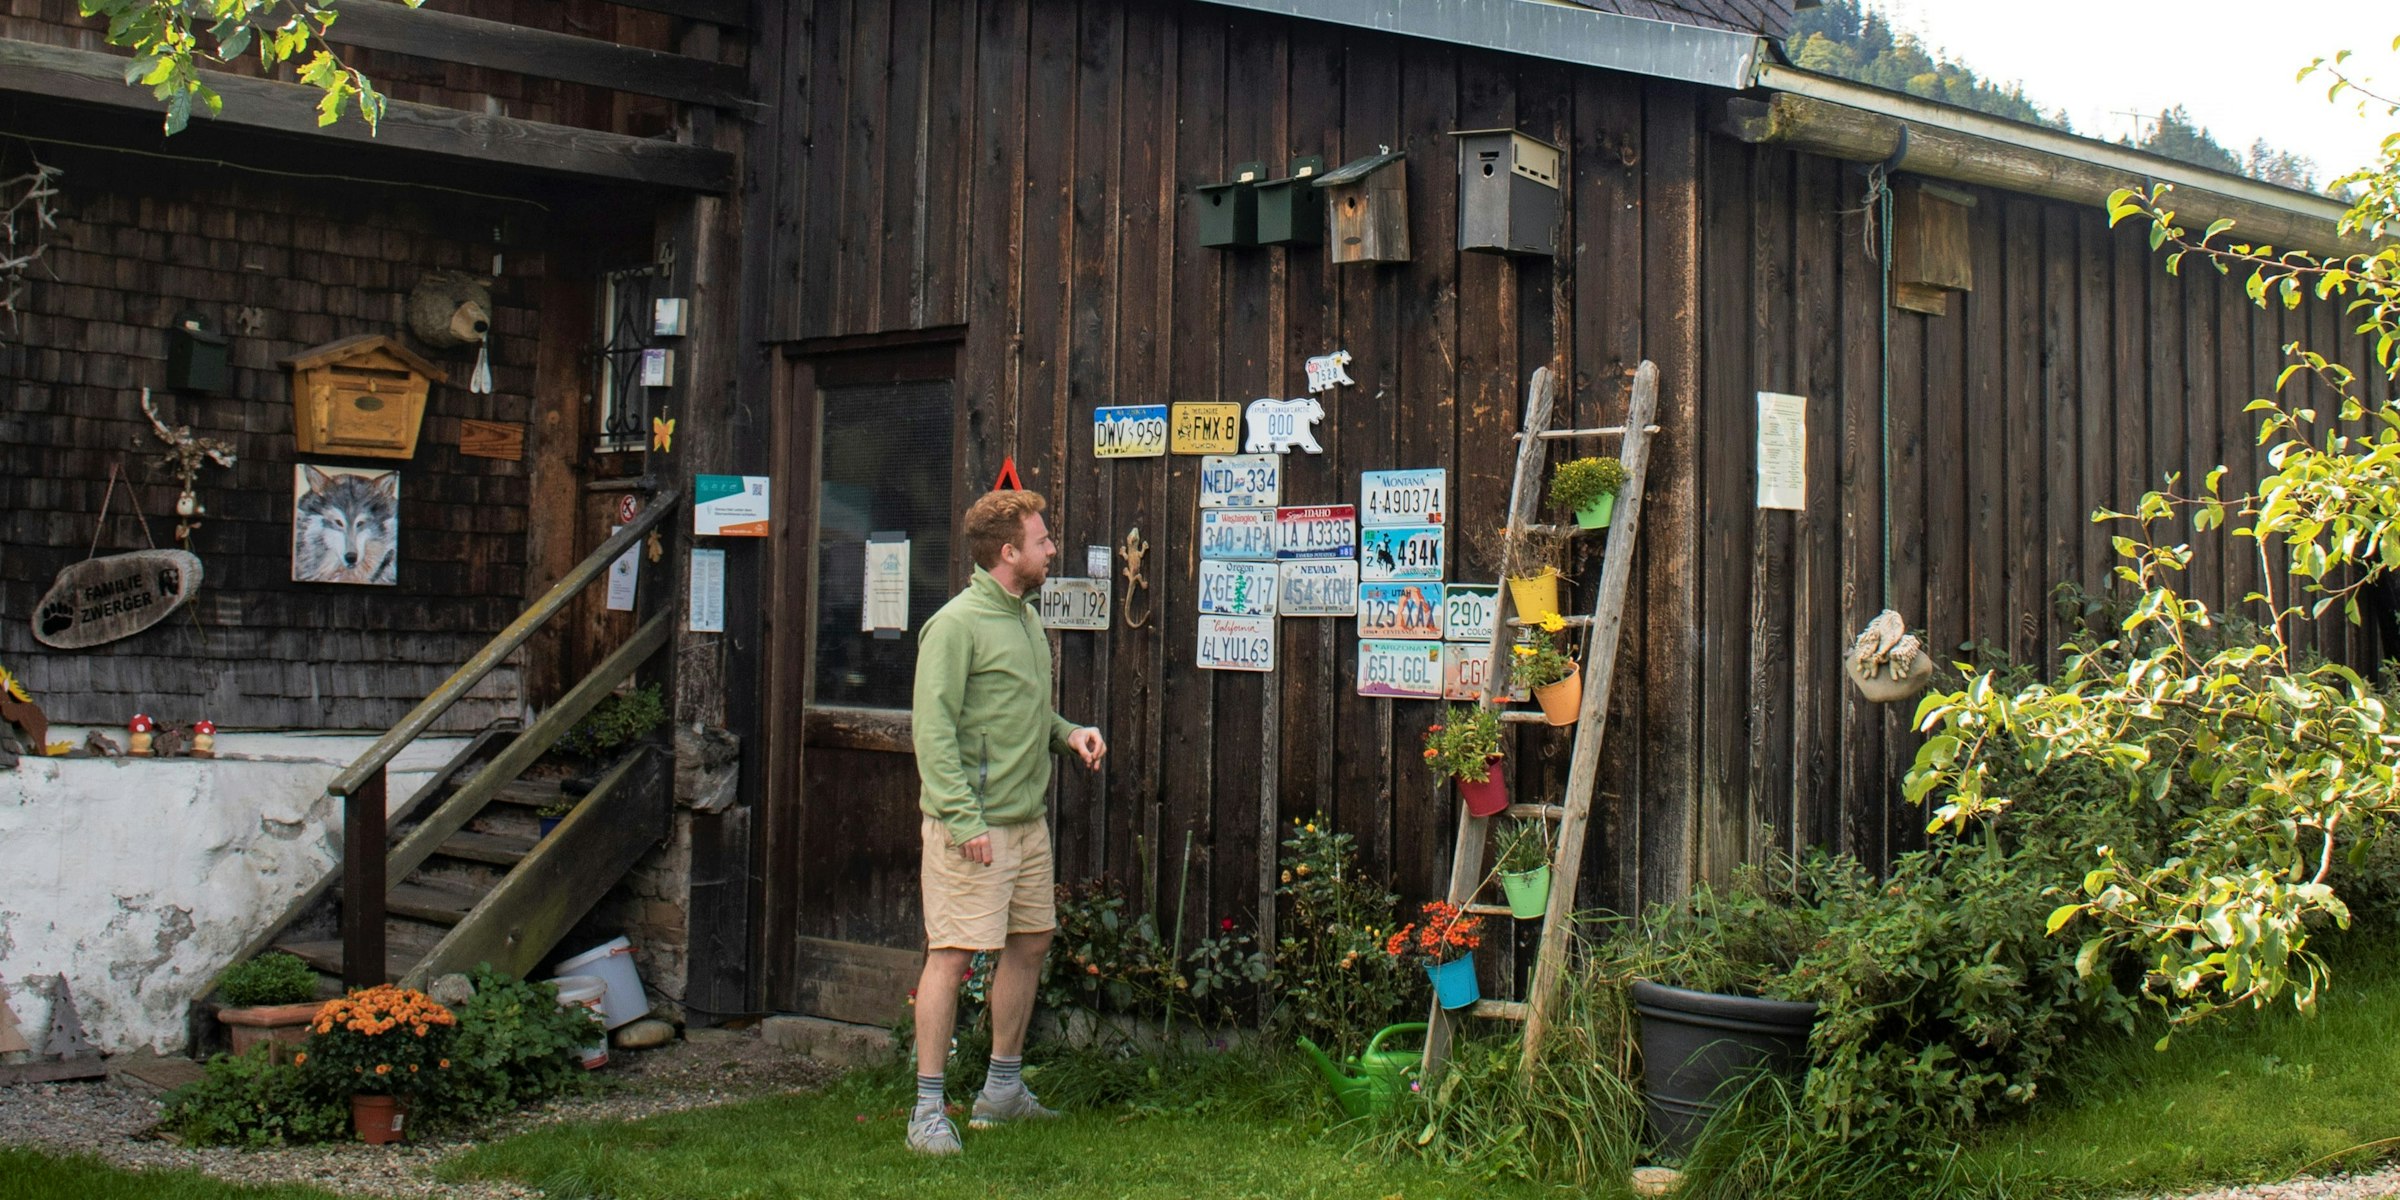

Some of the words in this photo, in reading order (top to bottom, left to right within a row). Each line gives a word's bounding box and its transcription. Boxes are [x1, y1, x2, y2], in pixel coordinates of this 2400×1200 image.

[1316, 367, 1338, 383] 7528
[1097, 422, 1125, 447] DWV
[1136, 421, 1163, 446] 959
[1190, 442, 1216, 450] YUKON
[1203, 469, 1233, 494] NED
[1246, 468, 1275, 493] 334
[1382, 477, 1426, 487] MONTANA
[1222, 514, 1258, 525] Washington
[1304, 508, 1331, 518] IDAHO
[1398, 539, 1439, 567] 434K
[1226, 562, 1254, 574] Oregon
[1300, 565, 1337, 574] NEVADA
[85, 574, 143, 601] FAMILIE
[1203, 573, 1235, 602] XGE
[1244, 575, 1274, 605] 217
[1391, 589, 1412, 597] UTAH
[81, 591, 153, 624] ZWERGER
[1043, 591, 1071, 617] HPW
[1083, 591, 1106, 618] 192
[1366, 600, 1396, 628] 125
[1406, 599, 1436, 628] XAX
[1450, 601, 1482, 626] 290
[1214, 620, 1260, 636] California
[1467, 628, 1492, 636] COLOR
[1202, 635, 1269, 663] 4LYU163
[1380, 644, 1422, 652] ARIZONA
[1368, 655, 1396, 683] 651
[1403, 656, 1431, 684] GGL
